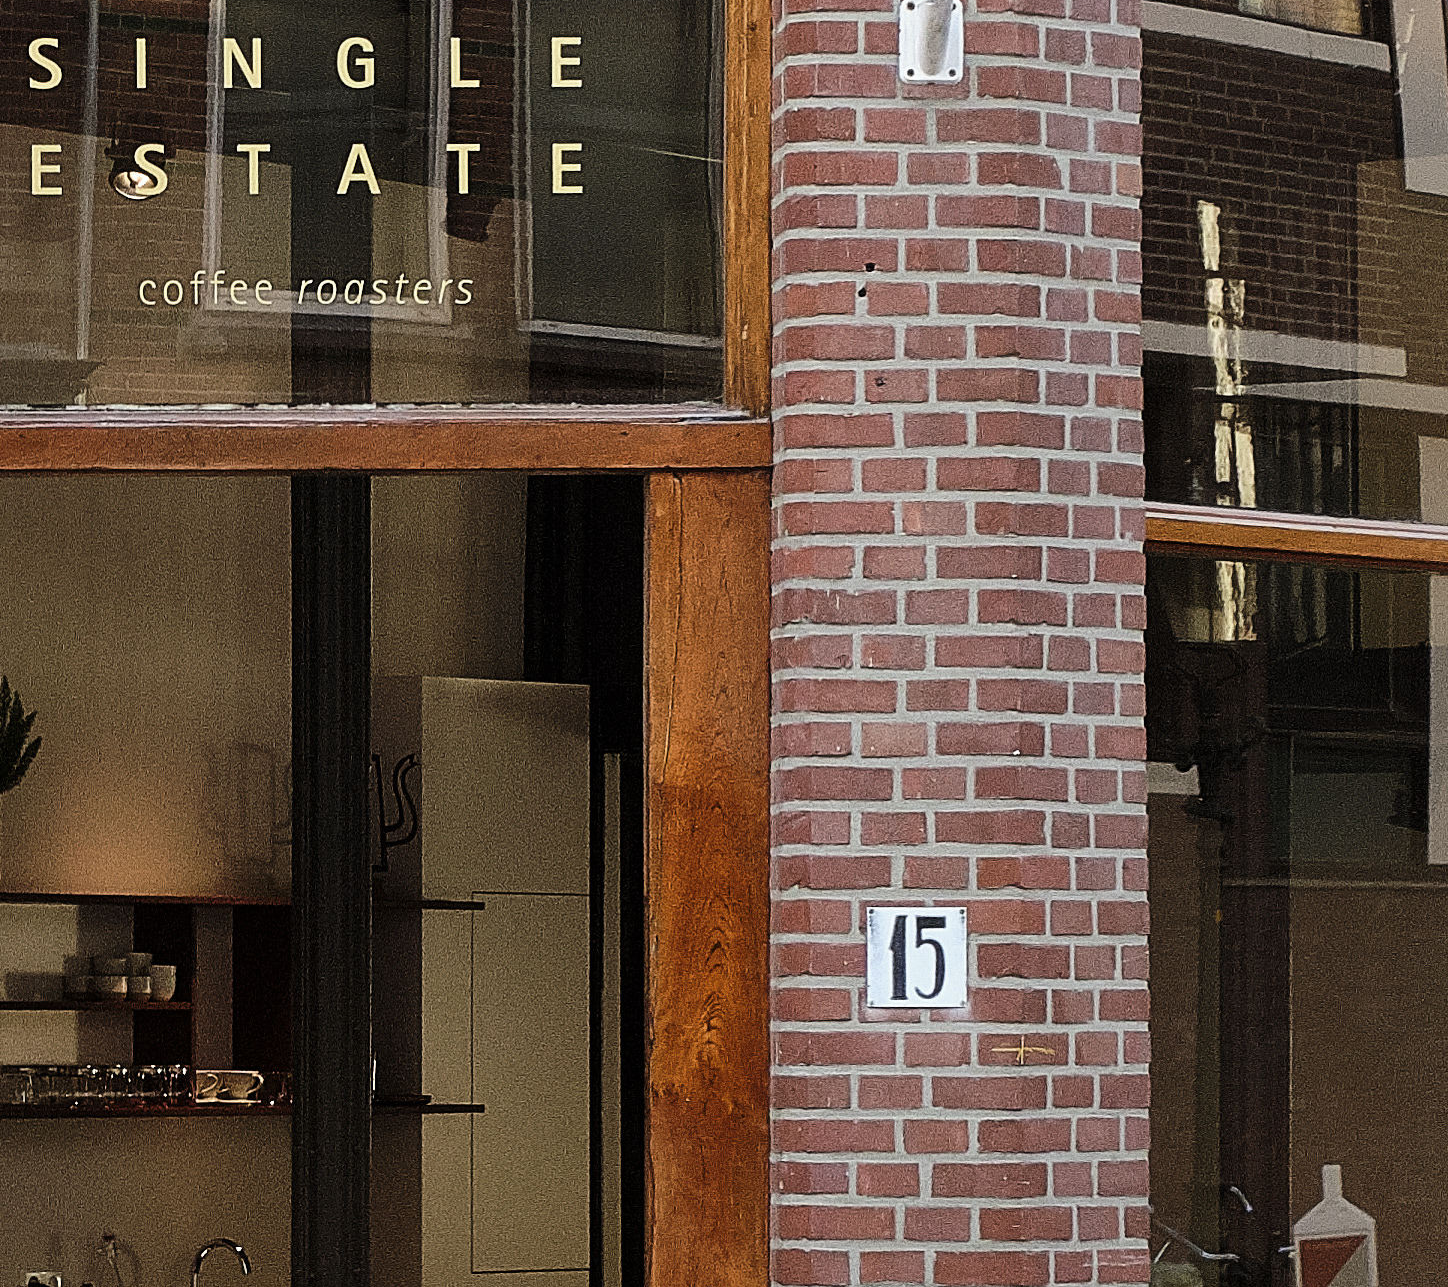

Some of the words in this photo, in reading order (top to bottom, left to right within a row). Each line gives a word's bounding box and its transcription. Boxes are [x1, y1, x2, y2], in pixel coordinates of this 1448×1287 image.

[28, 37, 583, 90] SINGLE
[29, 143, 584, 196] ESTATE
[138, 270, 274, 307] coffee
[297, 273, 475, 306] roasters
[888, 914, 946, 1000] 15
